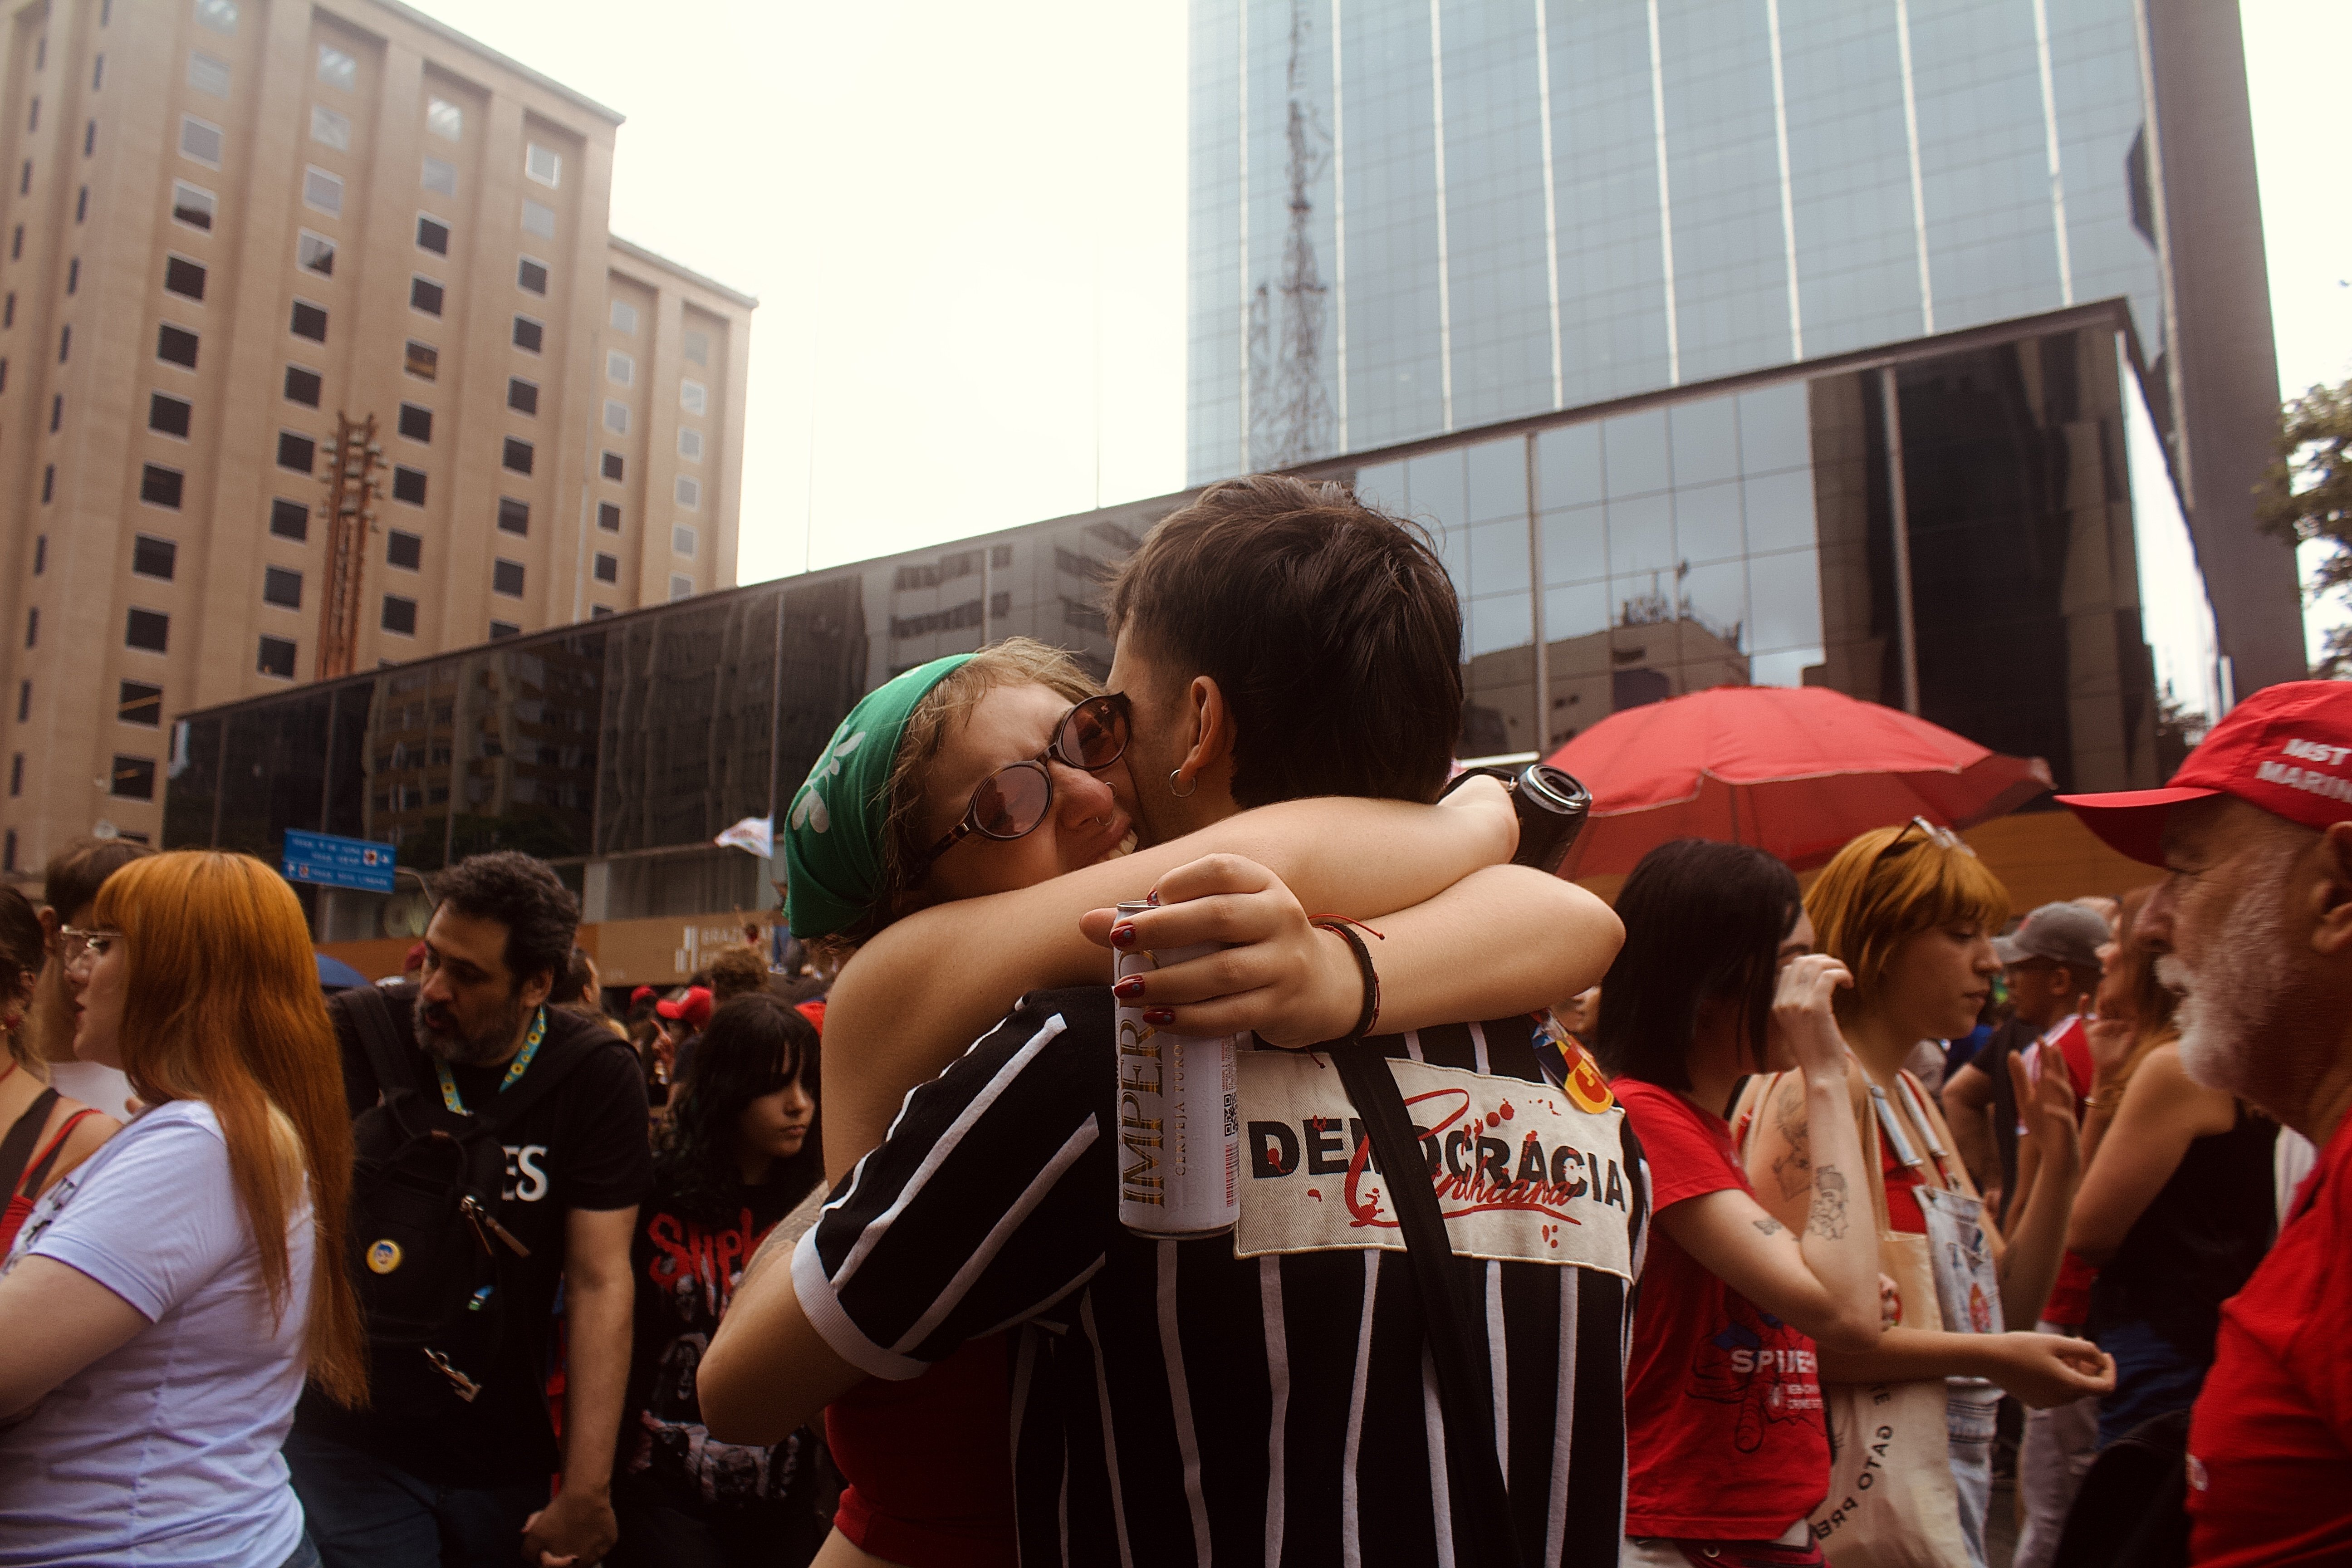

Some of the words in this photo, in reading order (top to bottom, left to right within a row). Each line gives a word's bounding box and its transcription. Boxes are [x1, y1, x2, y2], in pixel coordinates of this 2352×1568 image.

[1118, 949, 1165, 1208] IMPERO
[1173, 1045, 1184, 1093] PURO
[1174, 1102, 1186, 1176] CERVEJA
